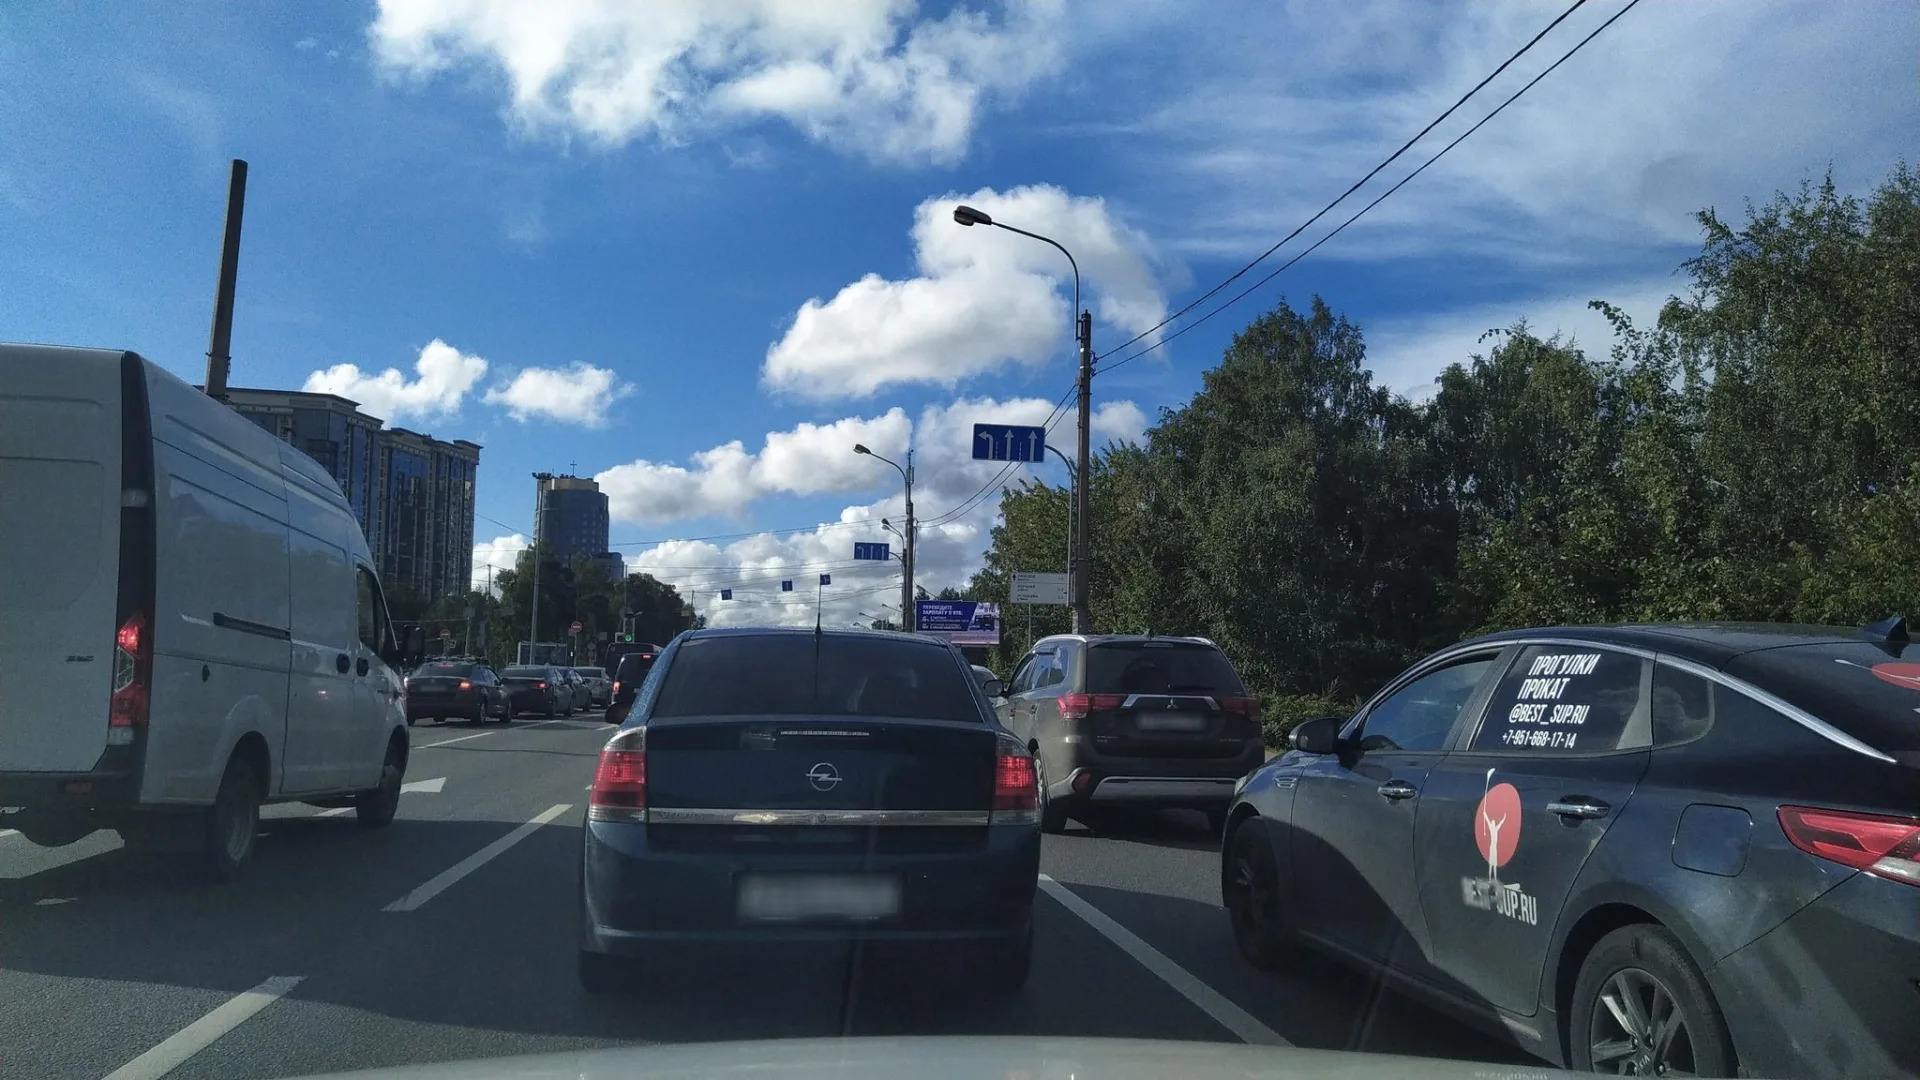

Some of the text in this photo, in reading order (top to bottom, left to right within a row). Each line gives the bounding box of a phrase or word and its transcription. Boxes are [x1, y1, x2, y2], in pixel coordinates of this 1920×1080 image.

[1528, 654, 1601, 676] ПРОГУЛКИ
[1517, 677, 1571, 699] ПРОКАТ
[1508, 703, 1590, 725] @BEST_SUP.RU
[1502, 729, 1577, 749] +7-951-668-17-14
[1638, 1054, 1651, 1070] KIA
